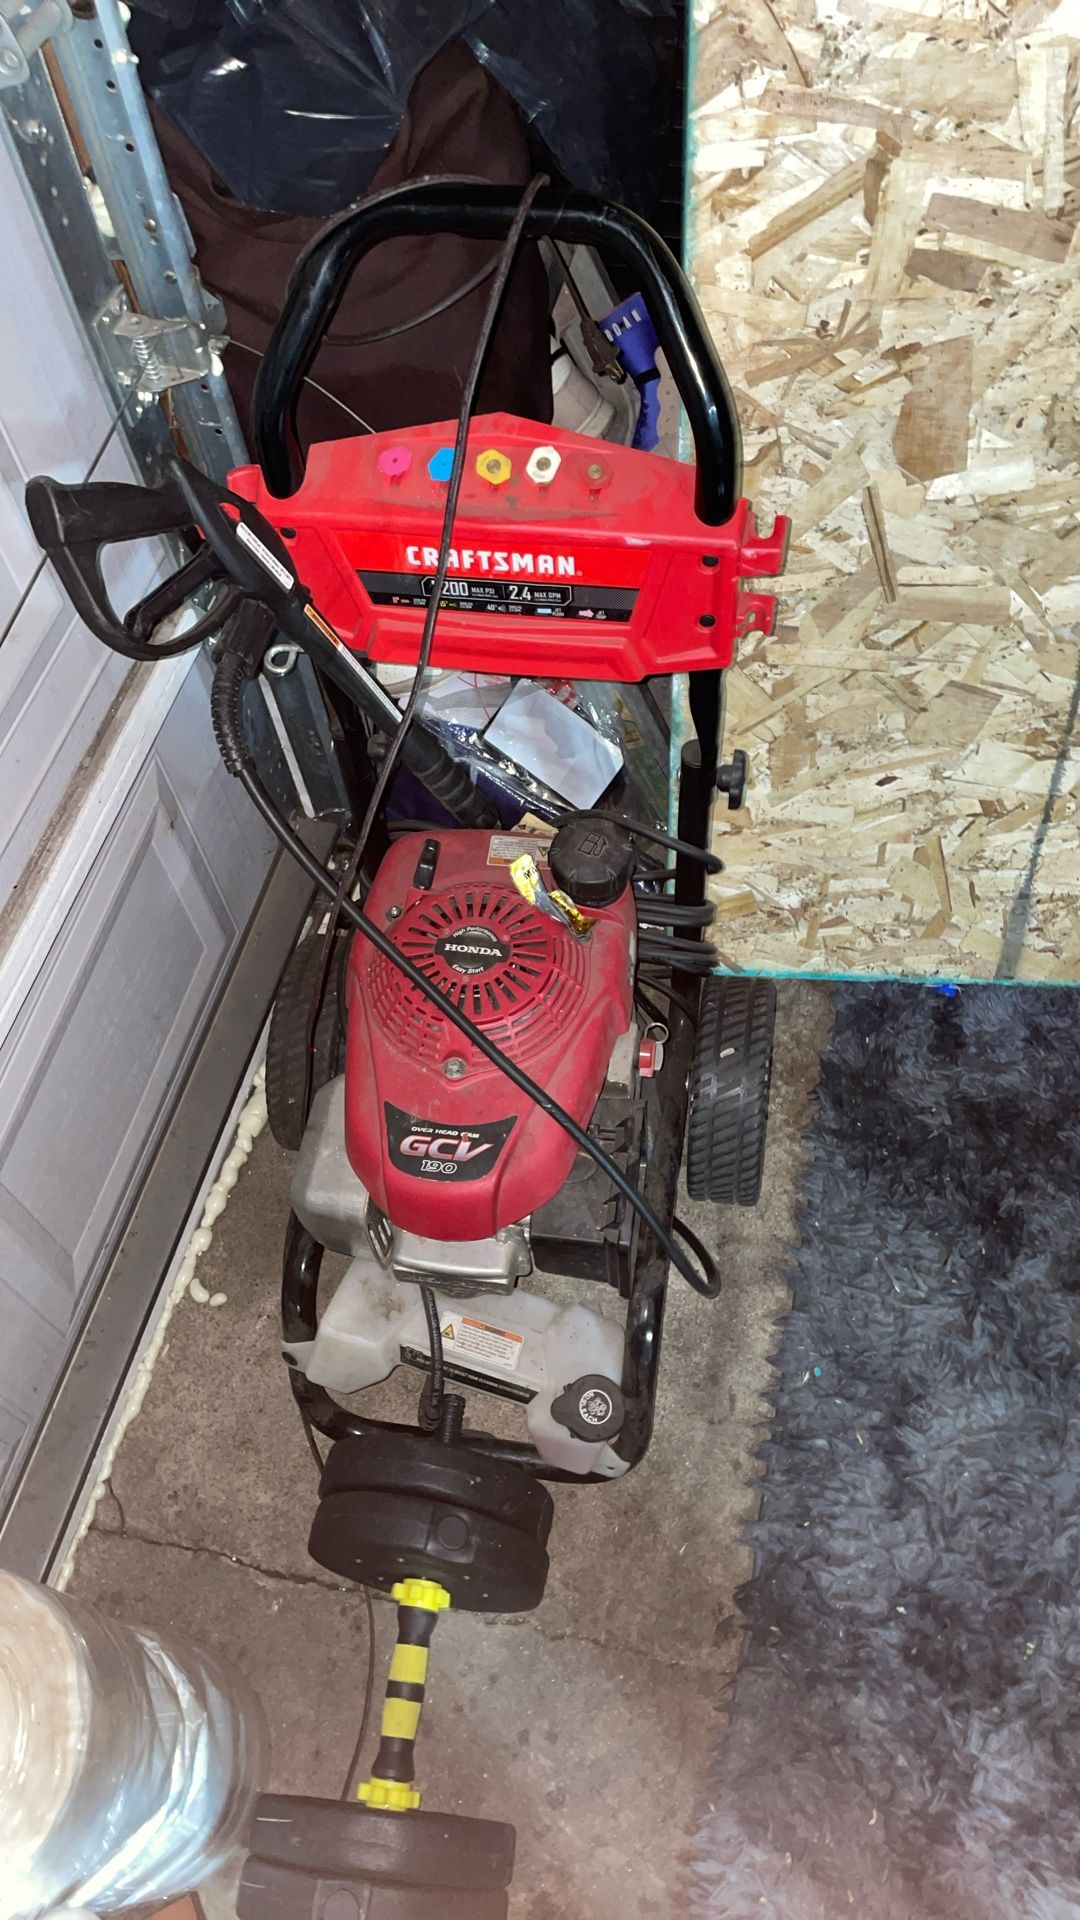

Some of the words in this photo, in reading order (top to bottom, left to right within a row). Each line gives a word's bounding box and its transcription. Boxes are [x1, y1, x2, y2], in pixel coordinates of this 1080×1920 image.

[405, 545, 576, 576] CRAFTSMAN
[430, 580, 469, 596] 200
[485, 587, 496, 595] PSI
[509, 585, 531, 600] 2.4
[444, 943, 503, 957] HONDA
[411, 1126, 434, 1134] OVER
[434, 1128, 459, 1136] HEAD
[460, 1131, 480, 1139] CAM
[400, 1135, 495, 1162] GCV
[420, 1160, 458, 1174] 190
